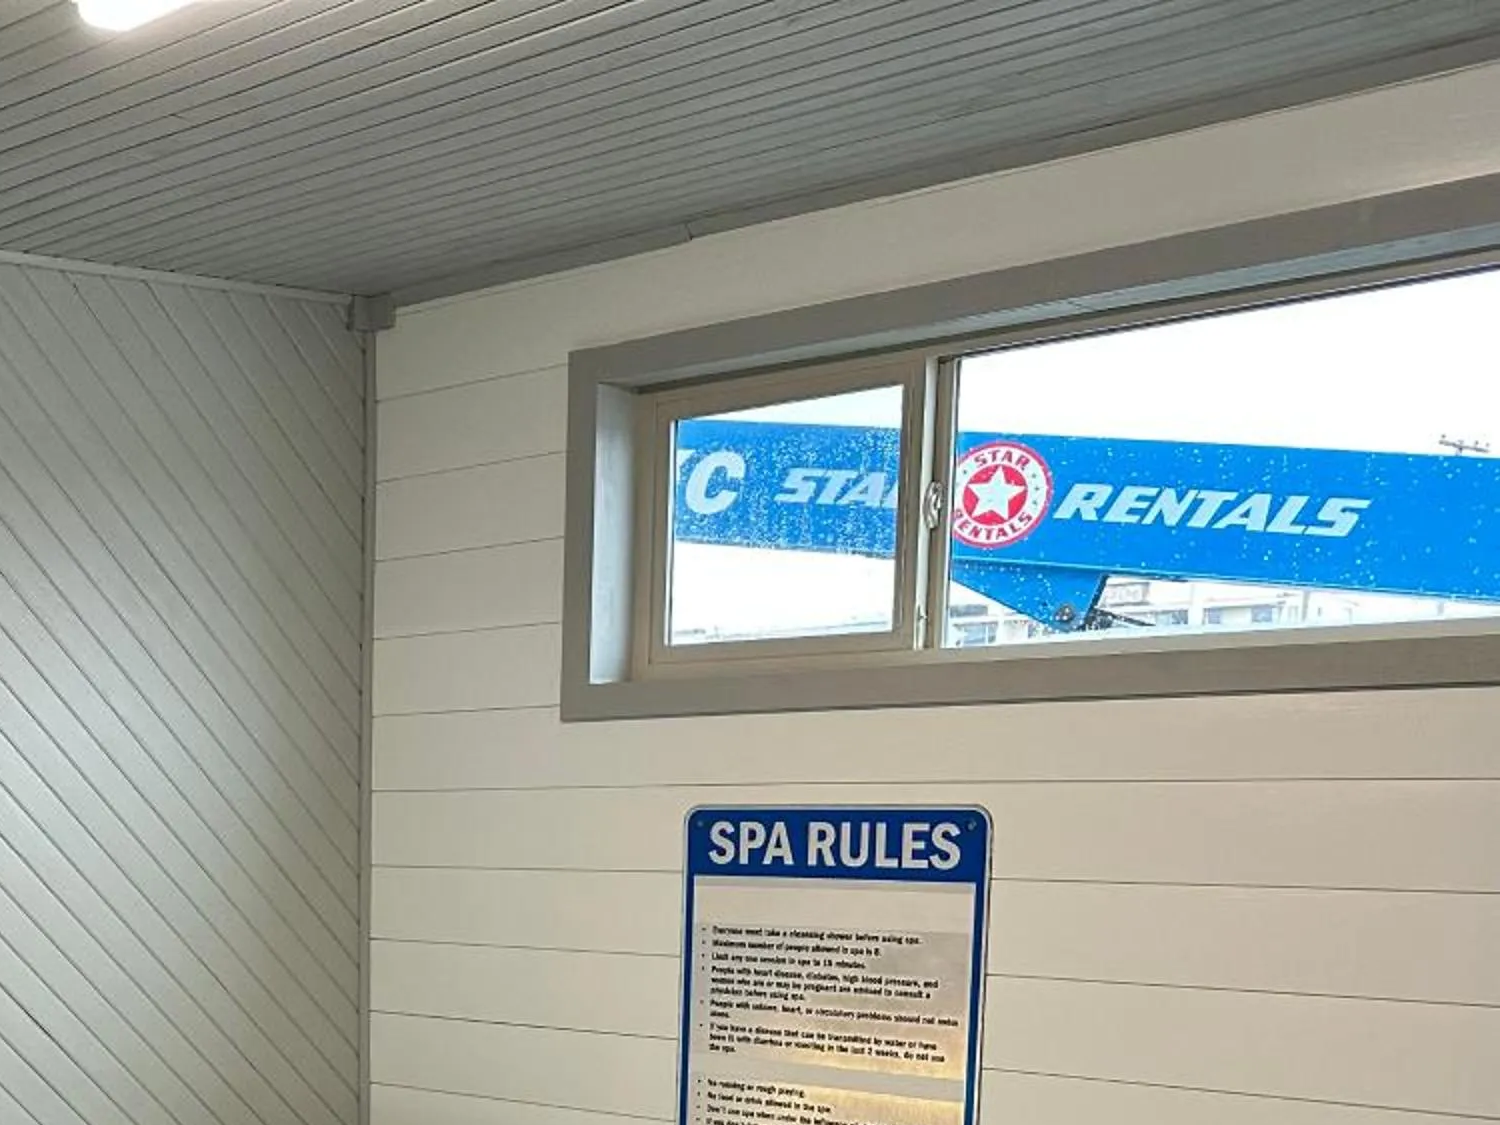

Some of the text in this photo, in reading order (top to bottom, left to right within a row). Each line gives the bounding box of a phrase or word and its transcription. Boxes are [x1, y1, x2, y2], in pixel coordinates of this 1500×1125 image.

[974, 450, 1031, 471] STAR
[1052, 483, 1372, 538] RENTALS
[708, 821, 962, 871] SPA RULES
